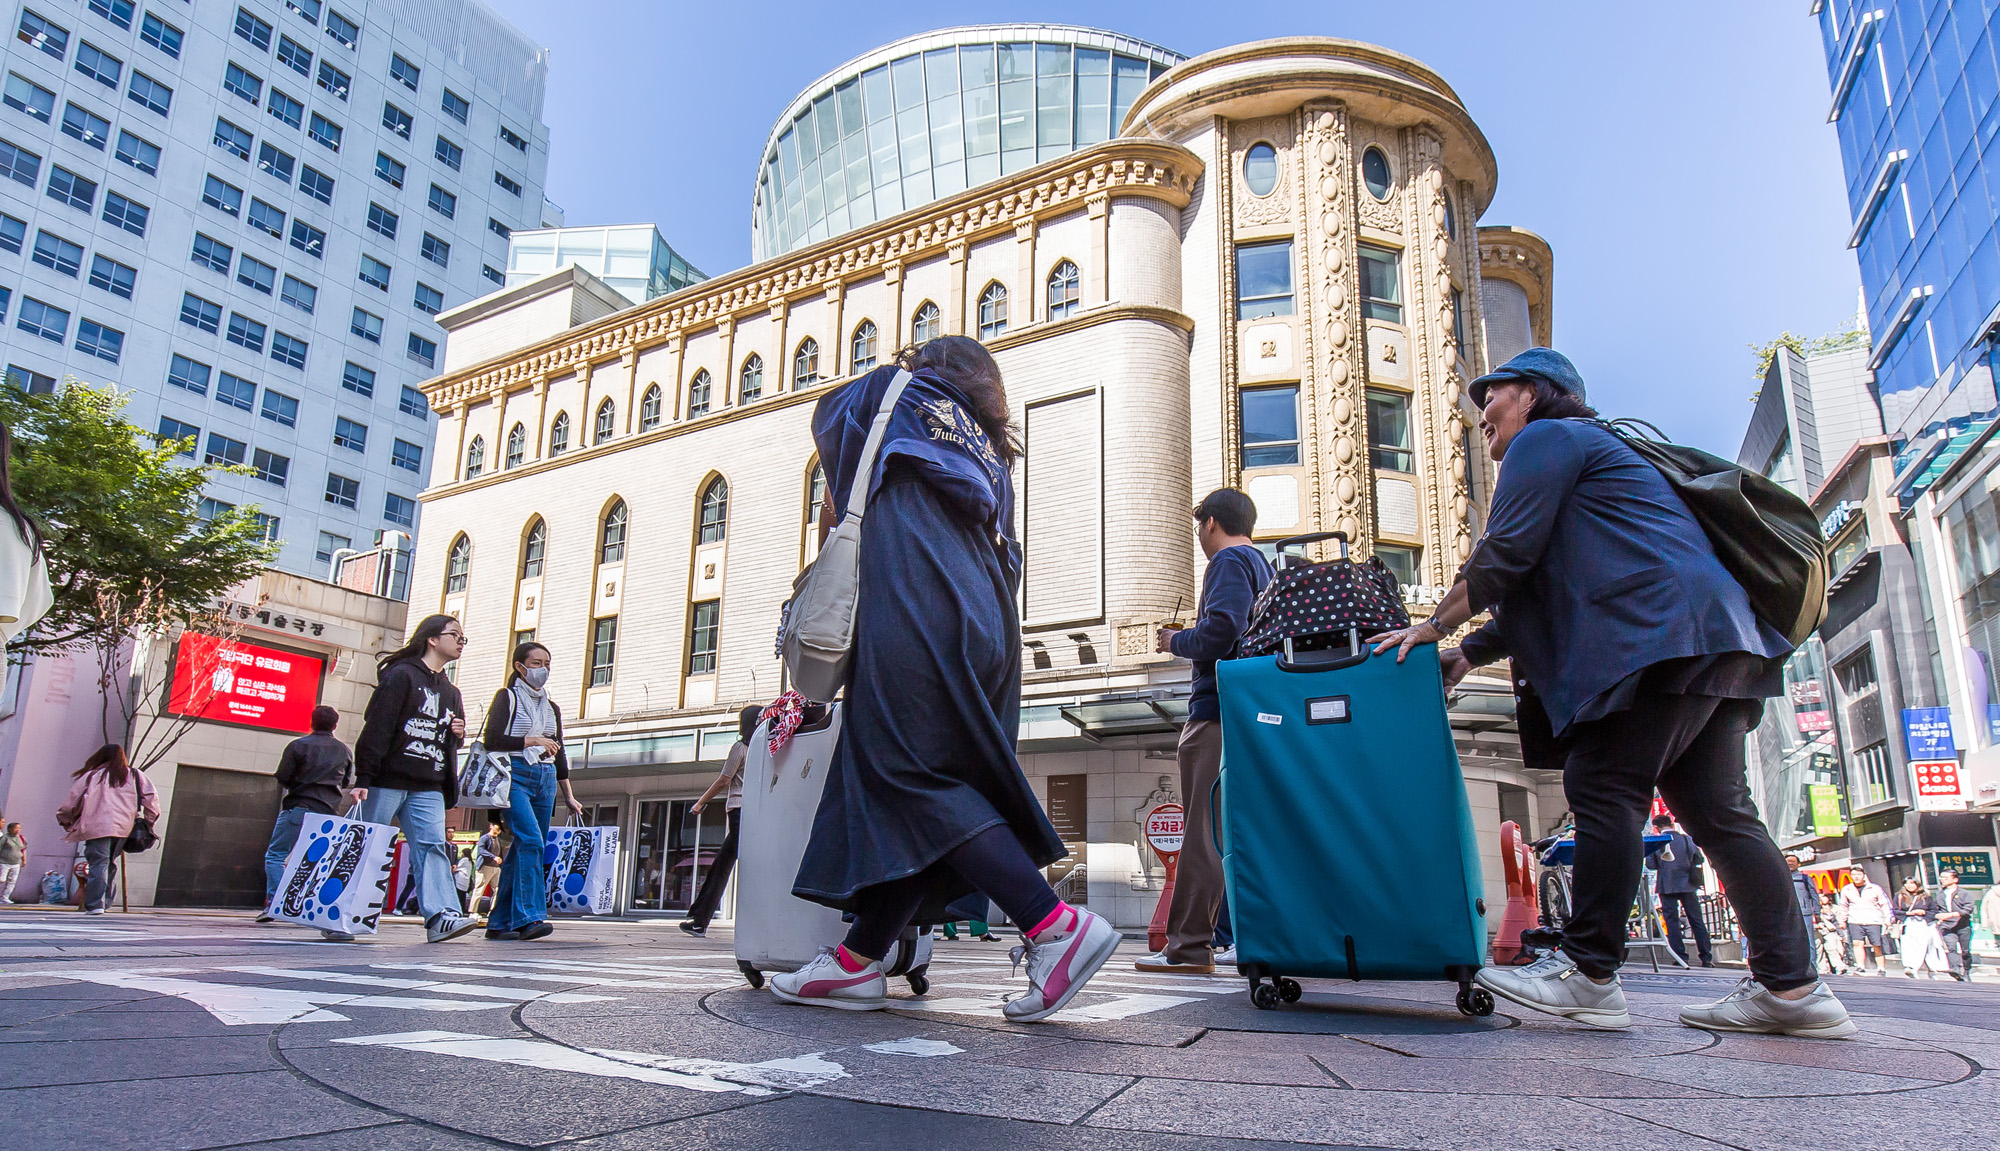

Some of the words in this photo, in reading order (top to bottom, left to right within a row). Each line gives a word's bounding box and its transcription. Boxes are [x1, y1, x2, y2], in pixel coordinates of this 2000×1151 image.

[929, 427, 965, 444] Juicy
[1398, 583, 1449, 605] YEO
[255, 656, 291, 673] 유료회원
[1925, 738, 1938, 746] 7F
[1921, 784, 1957, 793] daiso
[604, 877, 612, 894] YORK
